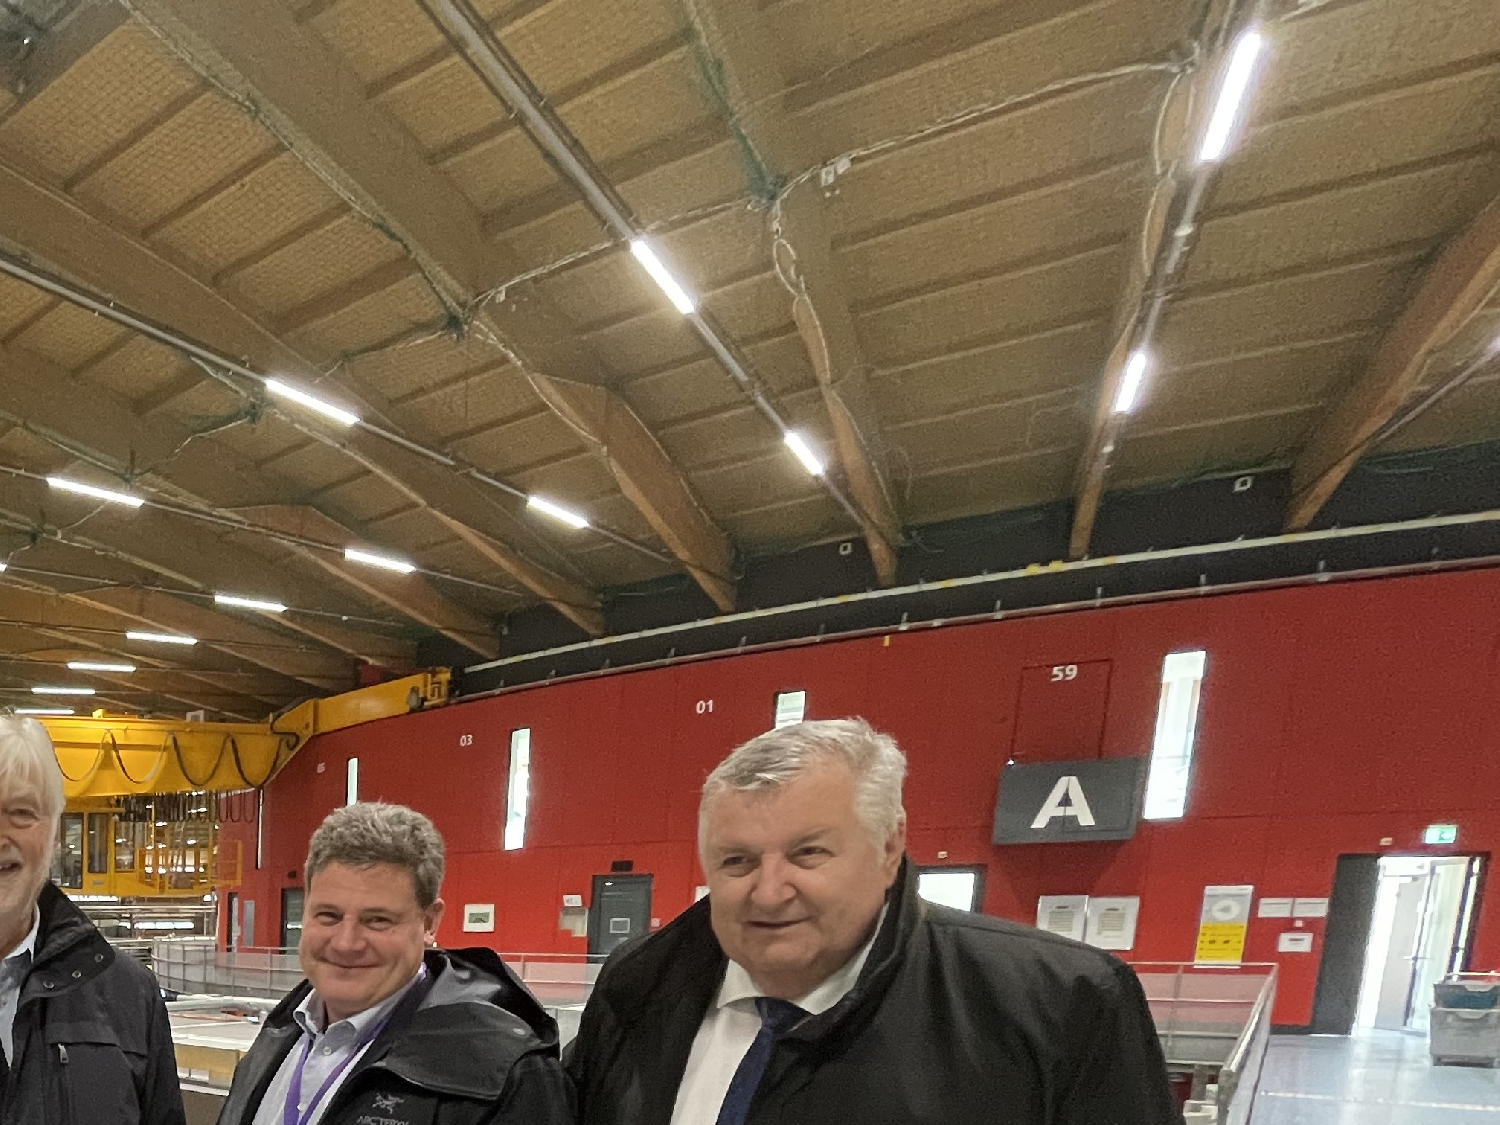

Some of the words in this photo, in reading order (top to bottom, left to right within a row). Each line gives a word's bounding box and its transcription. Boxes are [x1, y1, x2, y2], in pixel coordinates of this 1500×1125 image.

[1051, 664, 1078, 682] 59
[696, 699, 713, 714] 01
[460, 734, 473, 746] 03
[1030, 775, 1096, 828] A
